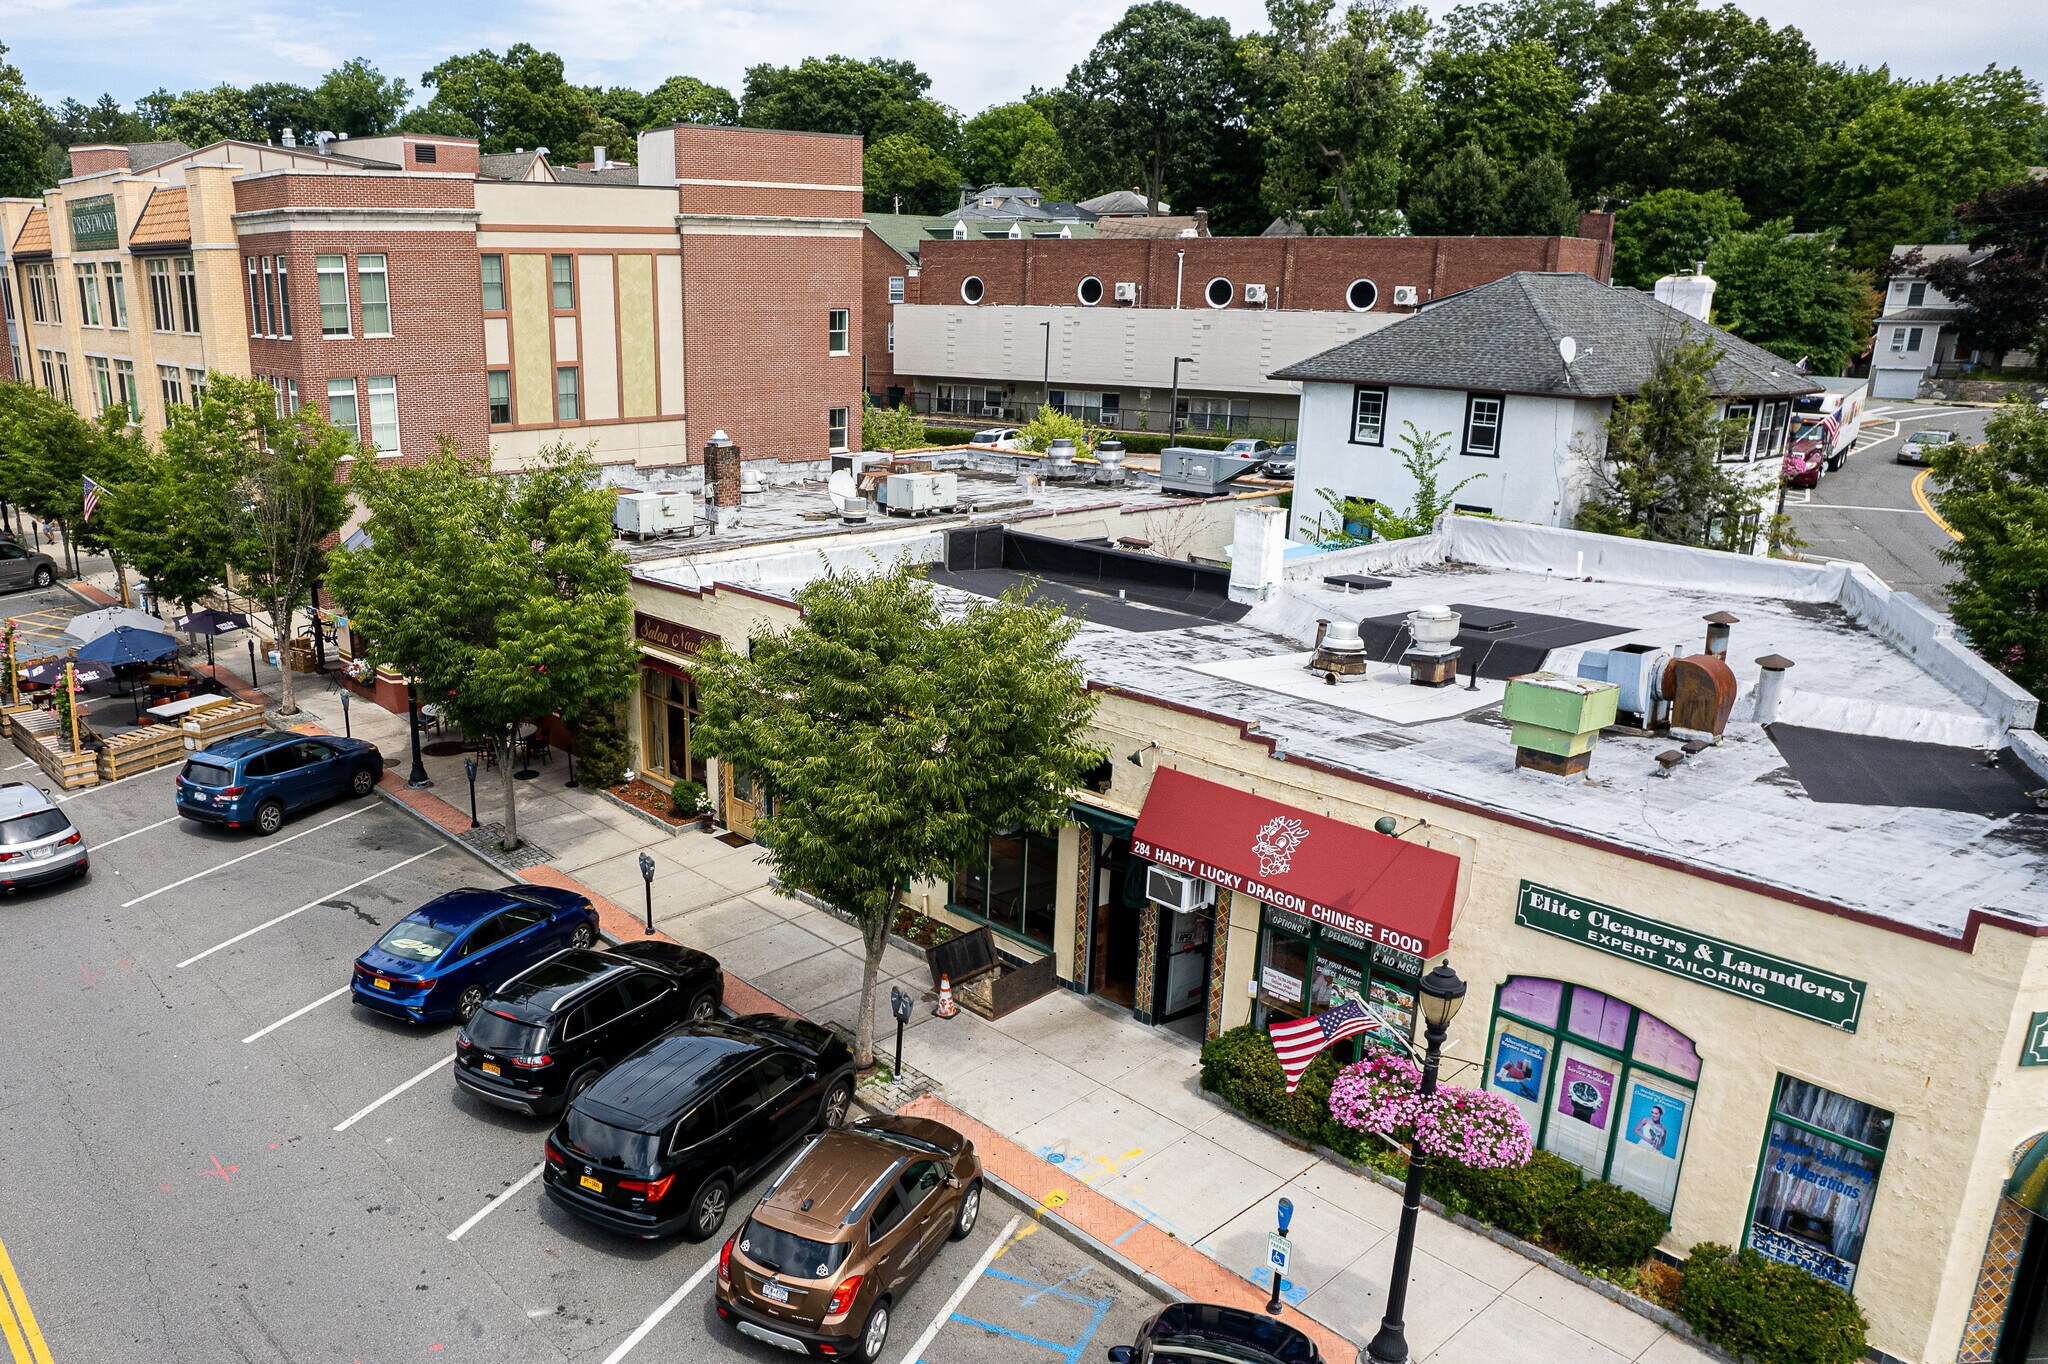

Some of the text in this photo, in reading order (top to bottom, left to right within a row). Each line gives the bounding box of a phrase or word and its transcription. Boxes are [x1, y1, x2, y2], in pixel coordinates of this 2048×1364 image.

[641, 620, 669, 644] Salon
[1134, 841, 1150, 857] 284
[1155, 848, 1196, 872] HAPPY
[1200, 863, 1242, 889] LUCKY
[1247, 881, 1306, 912] DRAGON
[1311, 904, 1374, 937] CHINESE
[1380, 928, 1423, 954] FOOD
[1272, 916, 1305, 934] OPTIONS!
[1327, 930, 1366, 951] DELICIOUS
[1528, 891, 1845, 1003] Elite Cleaners & Launders
[1382, 955, 1395, 967] NO
[1397, 960, 1421, 976] MSG!
[1396, 949, 1420, 965] FREE
[1587, 930, 1766, 995] EXPERT TAILORING
[1329, 959, 1343, 970] YOUR
[1343, 964, 1362, 979] TYPICAL
[1501, 1040, 1543, 1061] Repairs Available
[1504, 1037, 1529, 1050] Alteration
[1568, 1066, 1611, 1087] Service Available
[1577, 1064, 1604, 1080] Same Day
[1635, 1090, 1653, 1101] Cleaned
[1658, 1099, 1683, 1112] Preserved
[1770, 1133, 1873, 1184] Expert Tailoring
[1776, 1157, 1861, 1199] & Alterations
[1270, 1234, 1290, 1249] RESERVED
[1752, 1238, 1850, 1286] CLEANING
